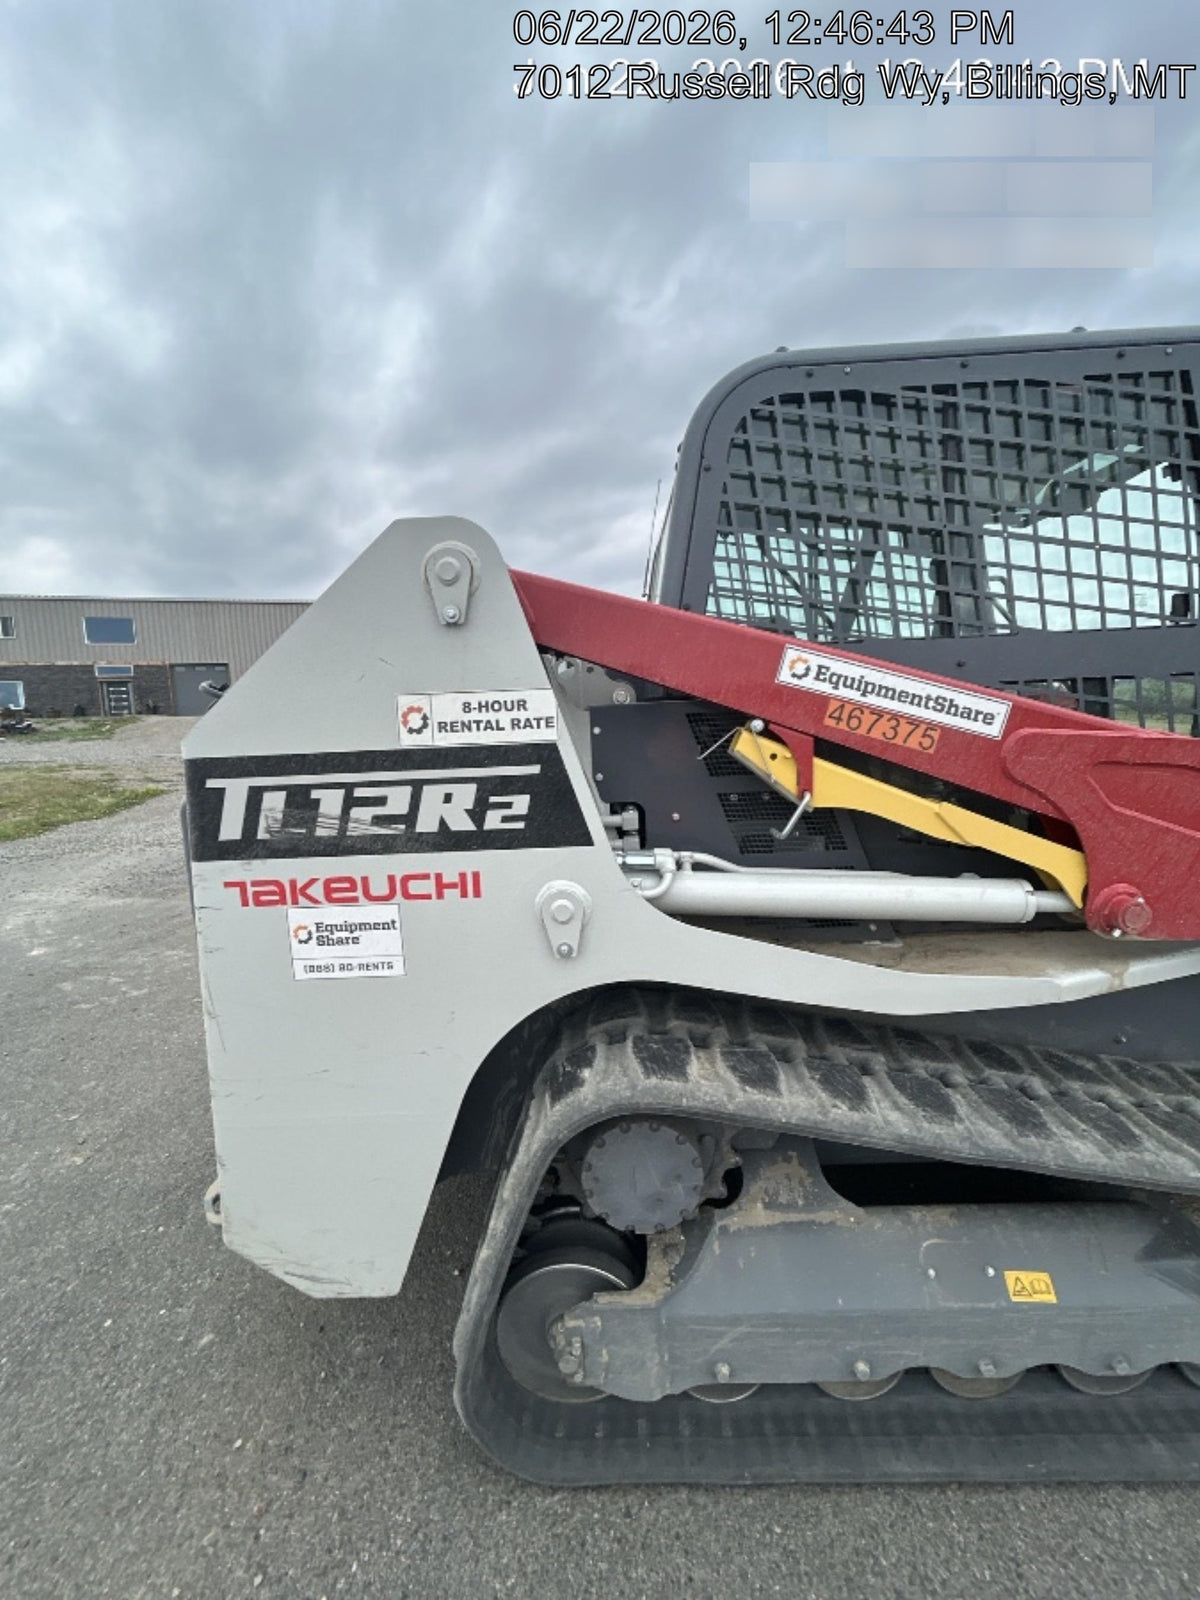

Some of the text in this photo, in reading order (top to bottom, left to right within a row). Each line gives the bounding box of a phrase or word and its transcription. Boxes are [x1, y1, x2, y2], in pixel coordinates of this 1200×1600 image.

[814, 664, 996, 726] EquipmentShare
[462, 699, 528, 714] 8-HOUR
[437, 716, 555, 733] RENTAL RATE
[828, 702, 938, 751] 467375
[314, 919, 398, 935] Equipment
[316, 935, 360, 946] Share
